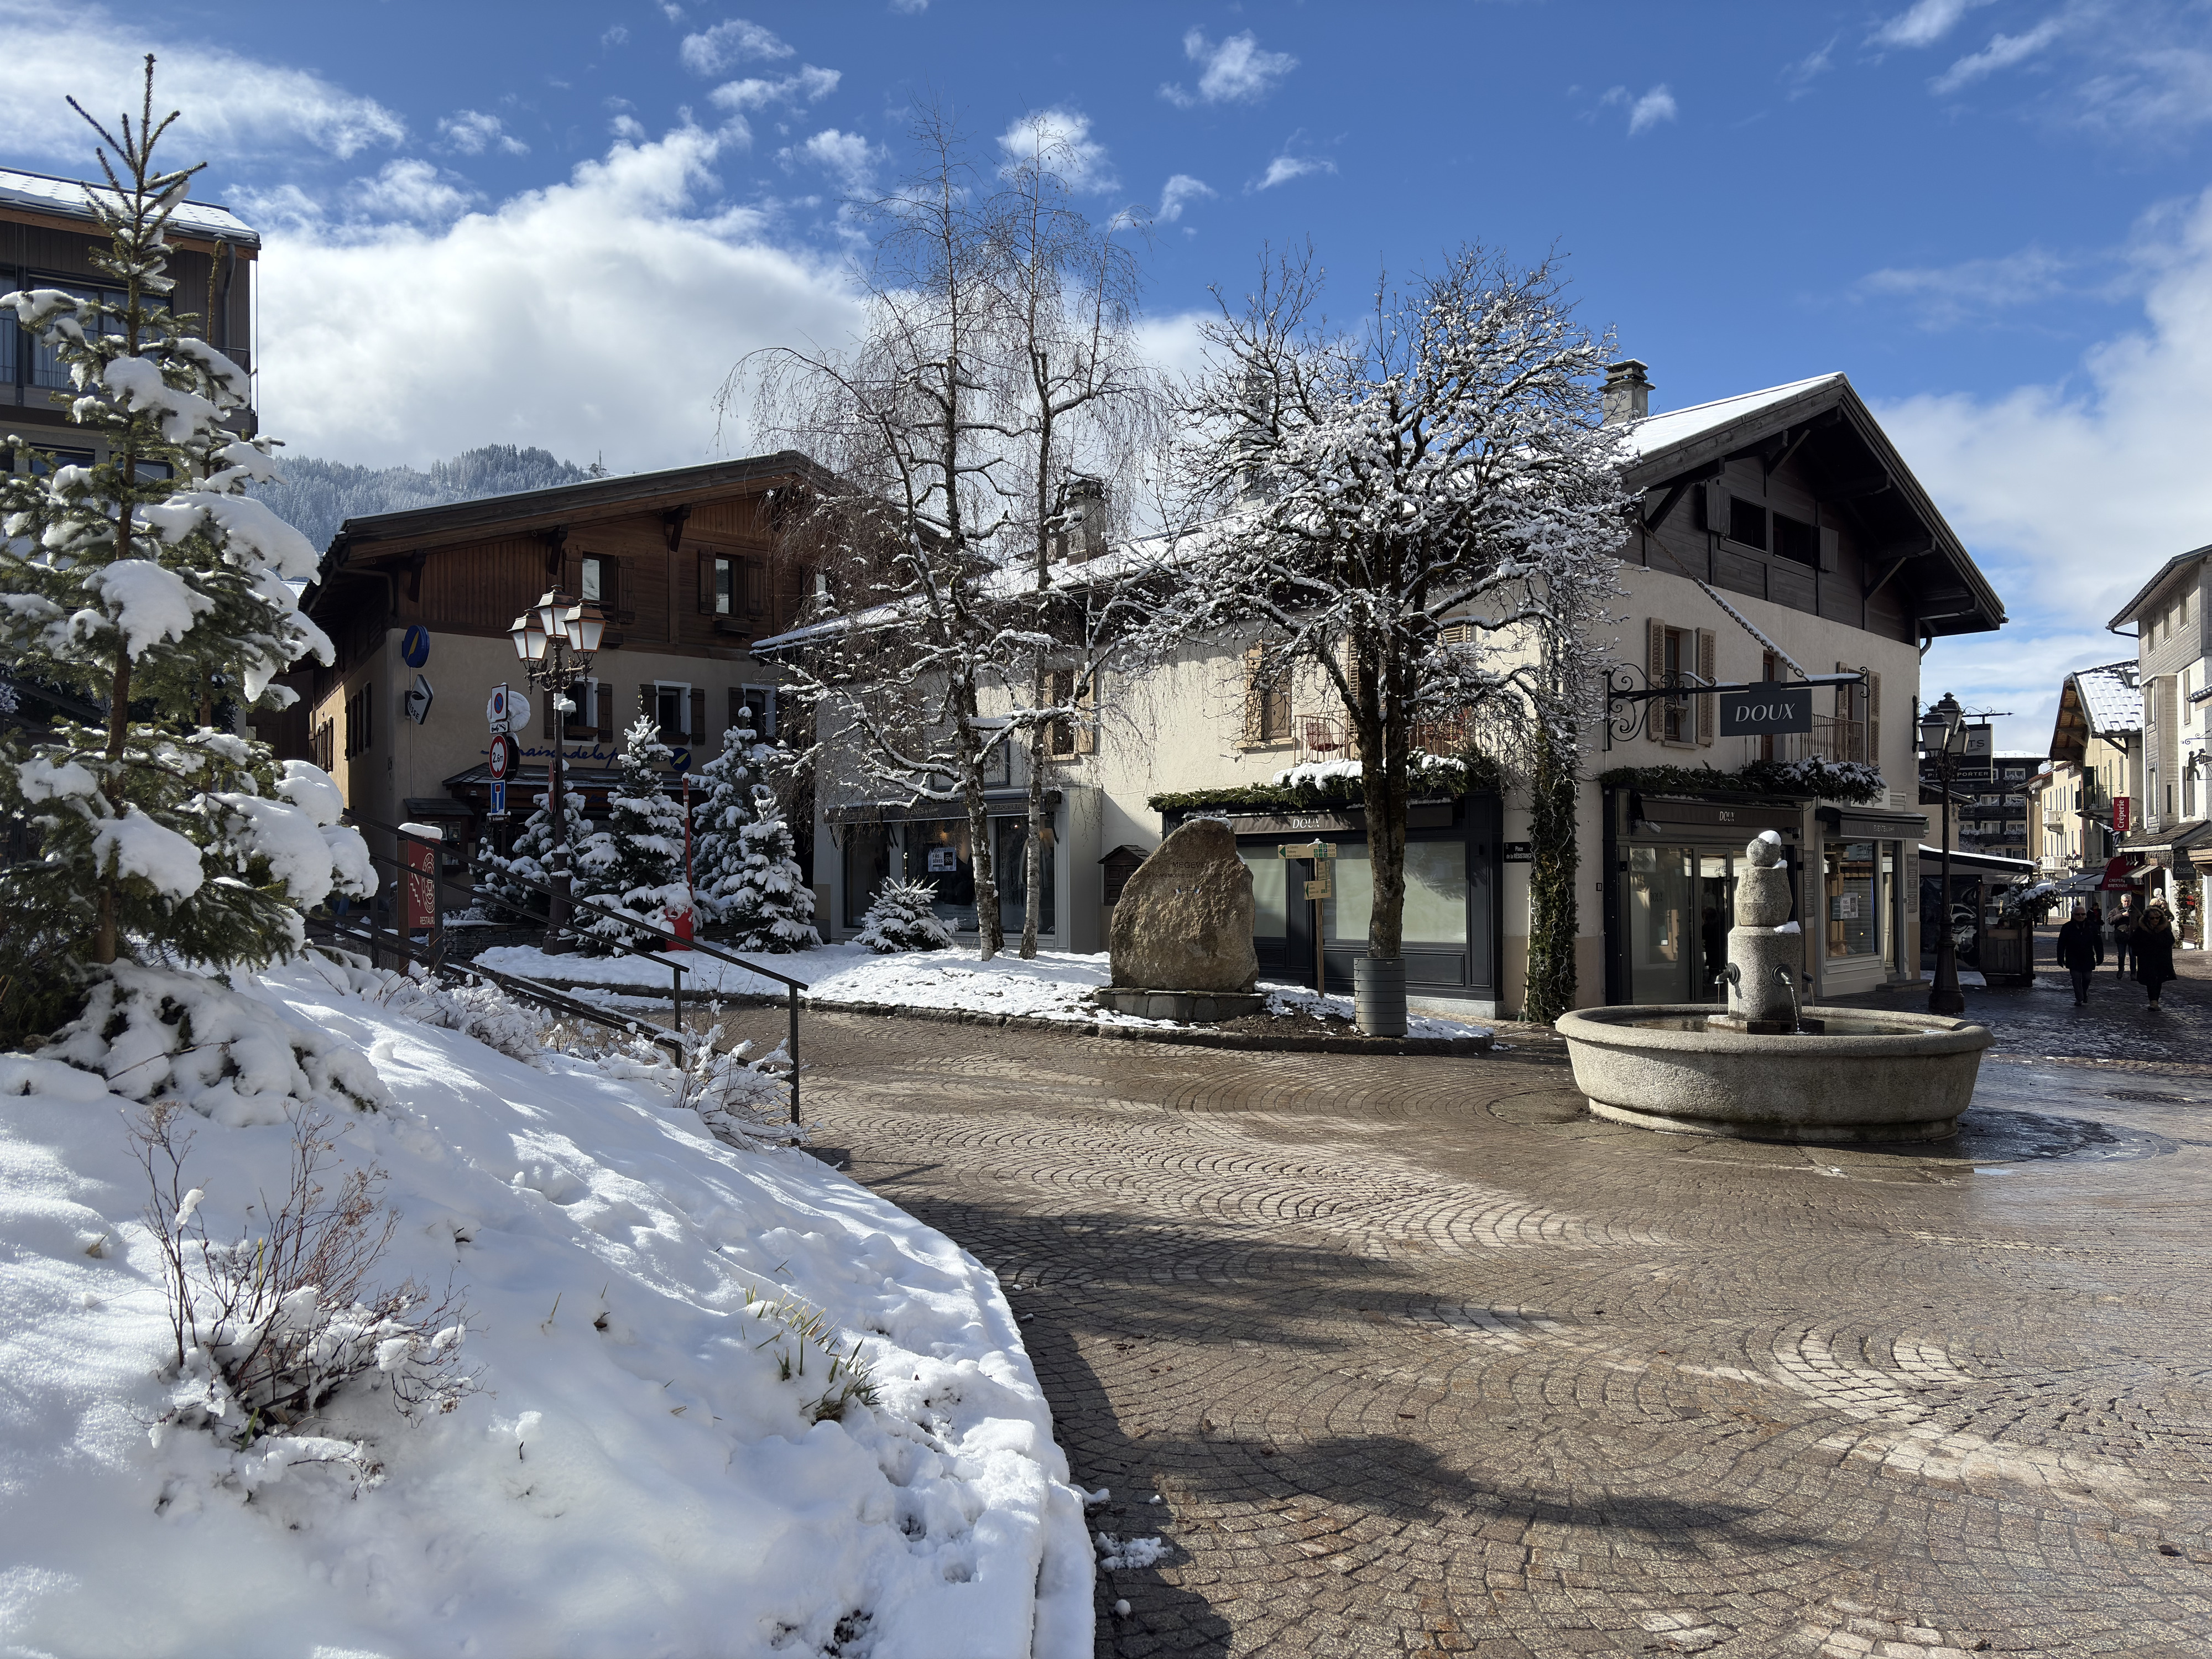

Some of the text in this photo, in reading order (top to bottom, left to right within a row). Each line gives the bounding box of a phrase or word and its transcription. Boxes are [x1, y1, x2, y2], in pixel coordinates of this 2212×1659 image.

[1735, 703, 1795, 722] DOUX
[493, 752, 503, 763] 2.6m
[1719, 811, 1735, 822] DOUX
[2117, 800, 2126, 828] Crêperie
[1292, 818, 1321, 828] DOUX
